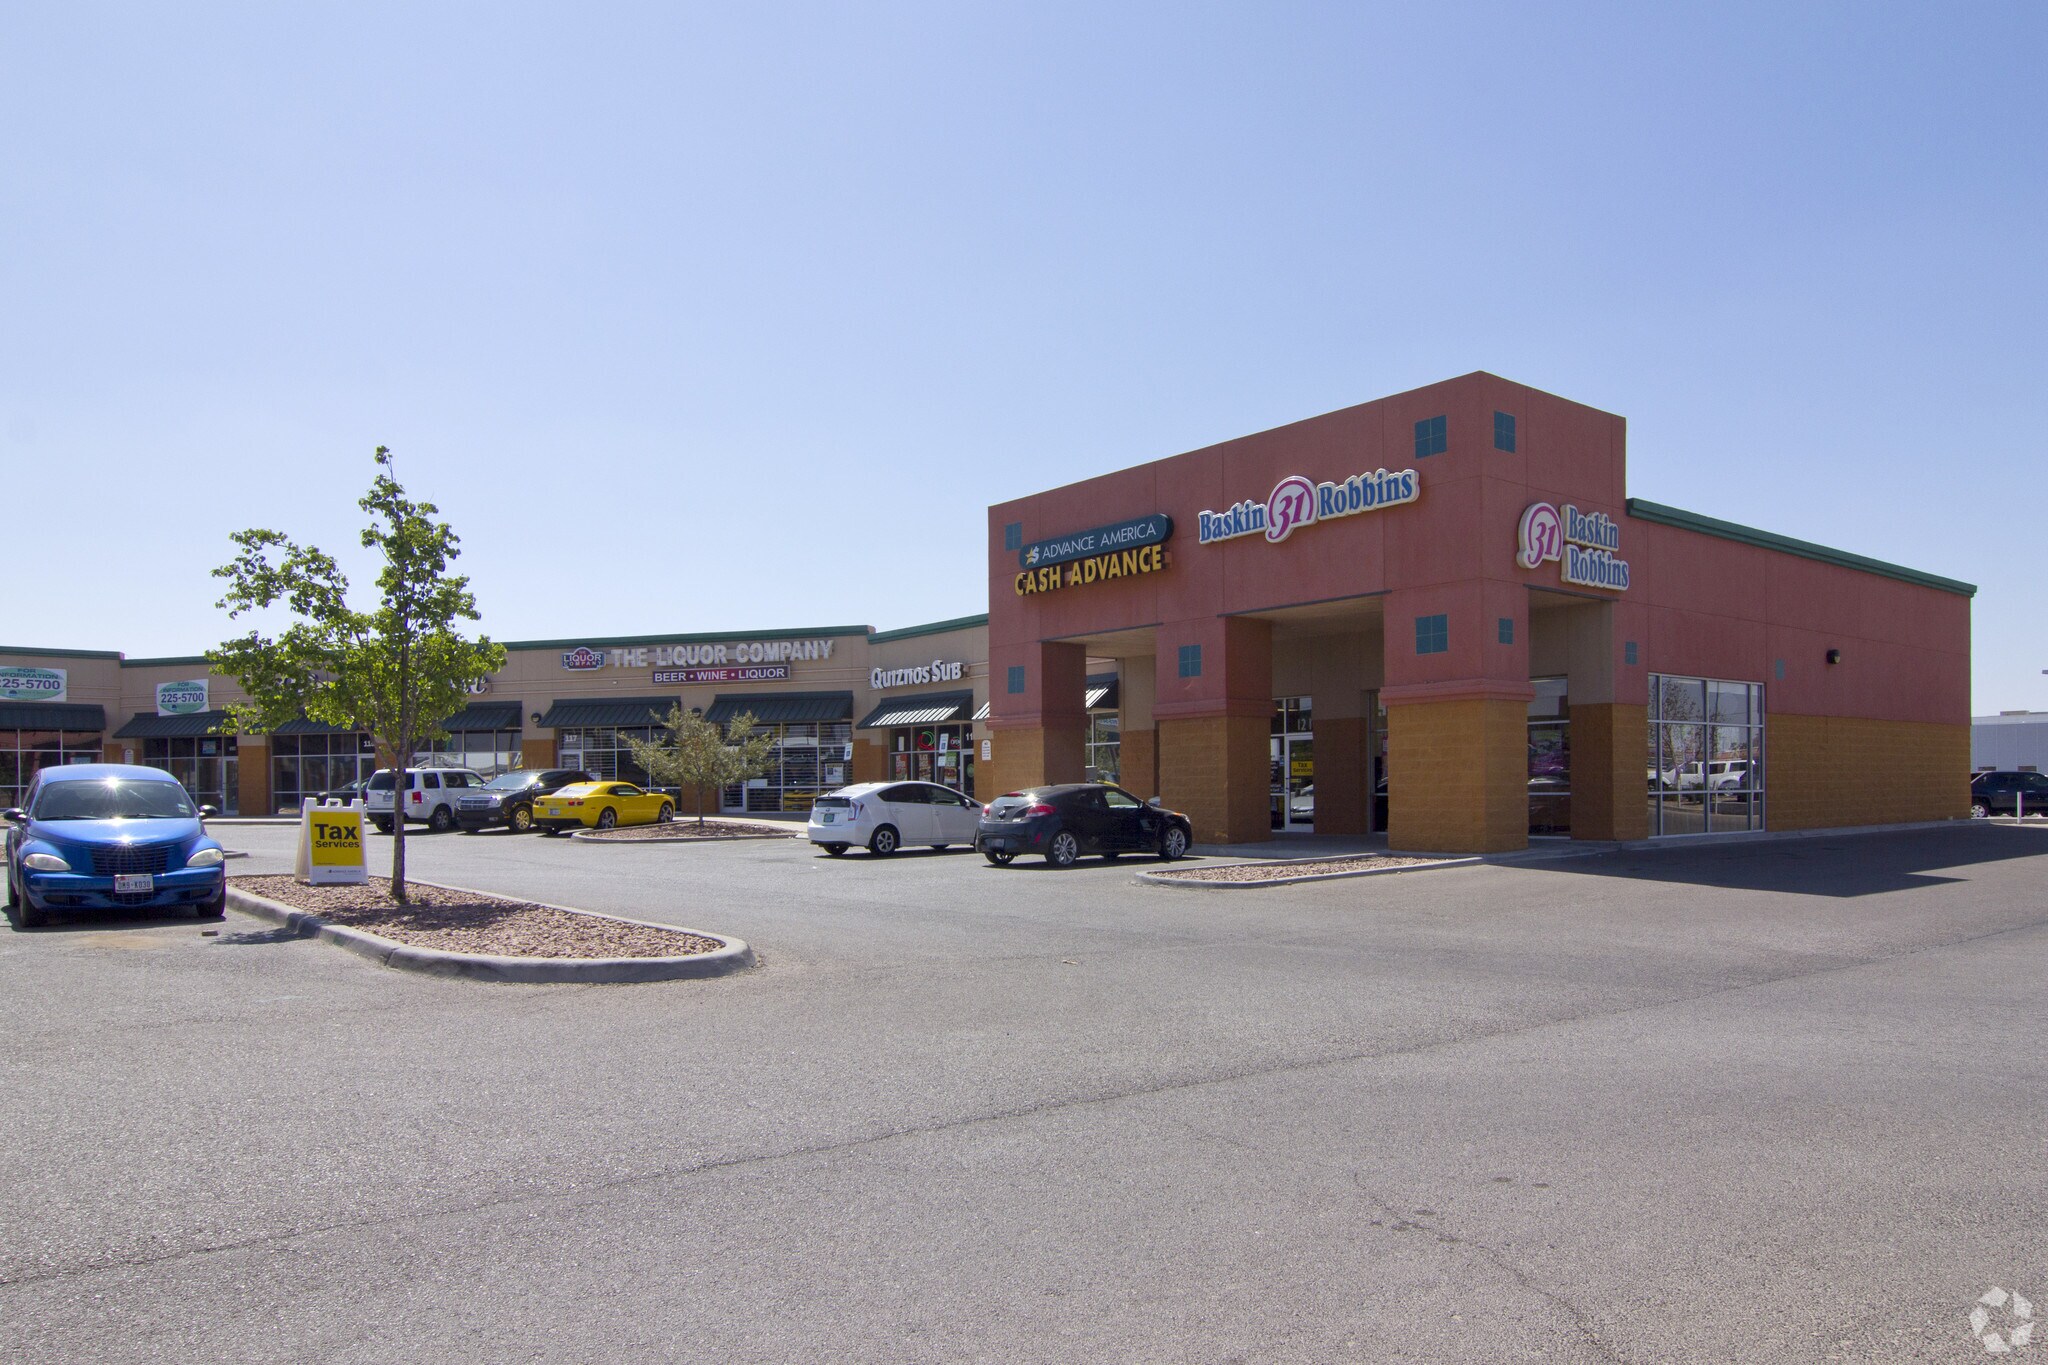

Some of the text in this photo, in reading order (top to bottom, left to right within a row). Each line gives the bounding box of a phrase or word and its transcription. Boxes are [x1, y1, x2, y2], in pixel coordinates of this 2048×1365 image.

[1199, 473, 1414, 542] Baskin 31 Robbins
[1568, 506, 1619, 549] Baskin
[1041, 522, 1157, 560] ADVANCE AMERICA
[1527, 521, 1557, 566] 31
[1014, 544, 1163, 597] CASH ADVANCE
[1569, 548, 1630, 588] Robbins
[563, 654, 602, 662] LIQUOR
[610, 639, 835, 668] THE LIQUOR COMPANY
[0, 672, 59, 680] NFORMATION
[0, 678, 61, 690] 25-5700
[654, 668, 786, 683] BEER WINE LIQUOR
[161, 692, 205, 703] 225-5700
[314, 823, 359, 840] Tax
[315, 840, 361, 849] Services
